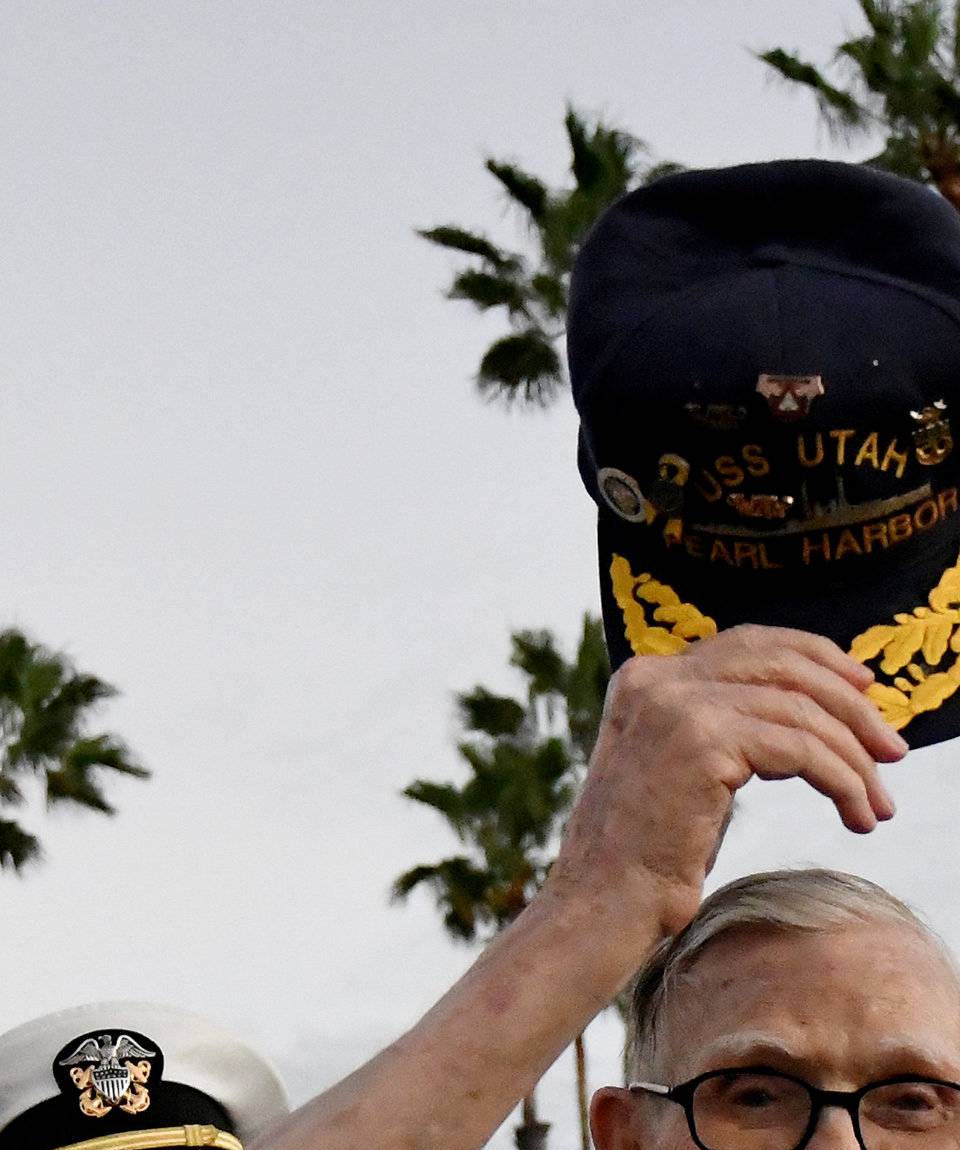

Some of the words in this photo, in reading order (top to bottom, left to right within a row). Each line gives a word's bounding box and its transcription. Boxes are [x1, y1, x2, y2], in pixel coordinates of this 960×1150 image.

[694, 443, 771, 502] USS
[797, 428, 909, 479] UTAH
[662, 530, 785, 569] EARL
[801, 486, 959, 566] HARBOR
